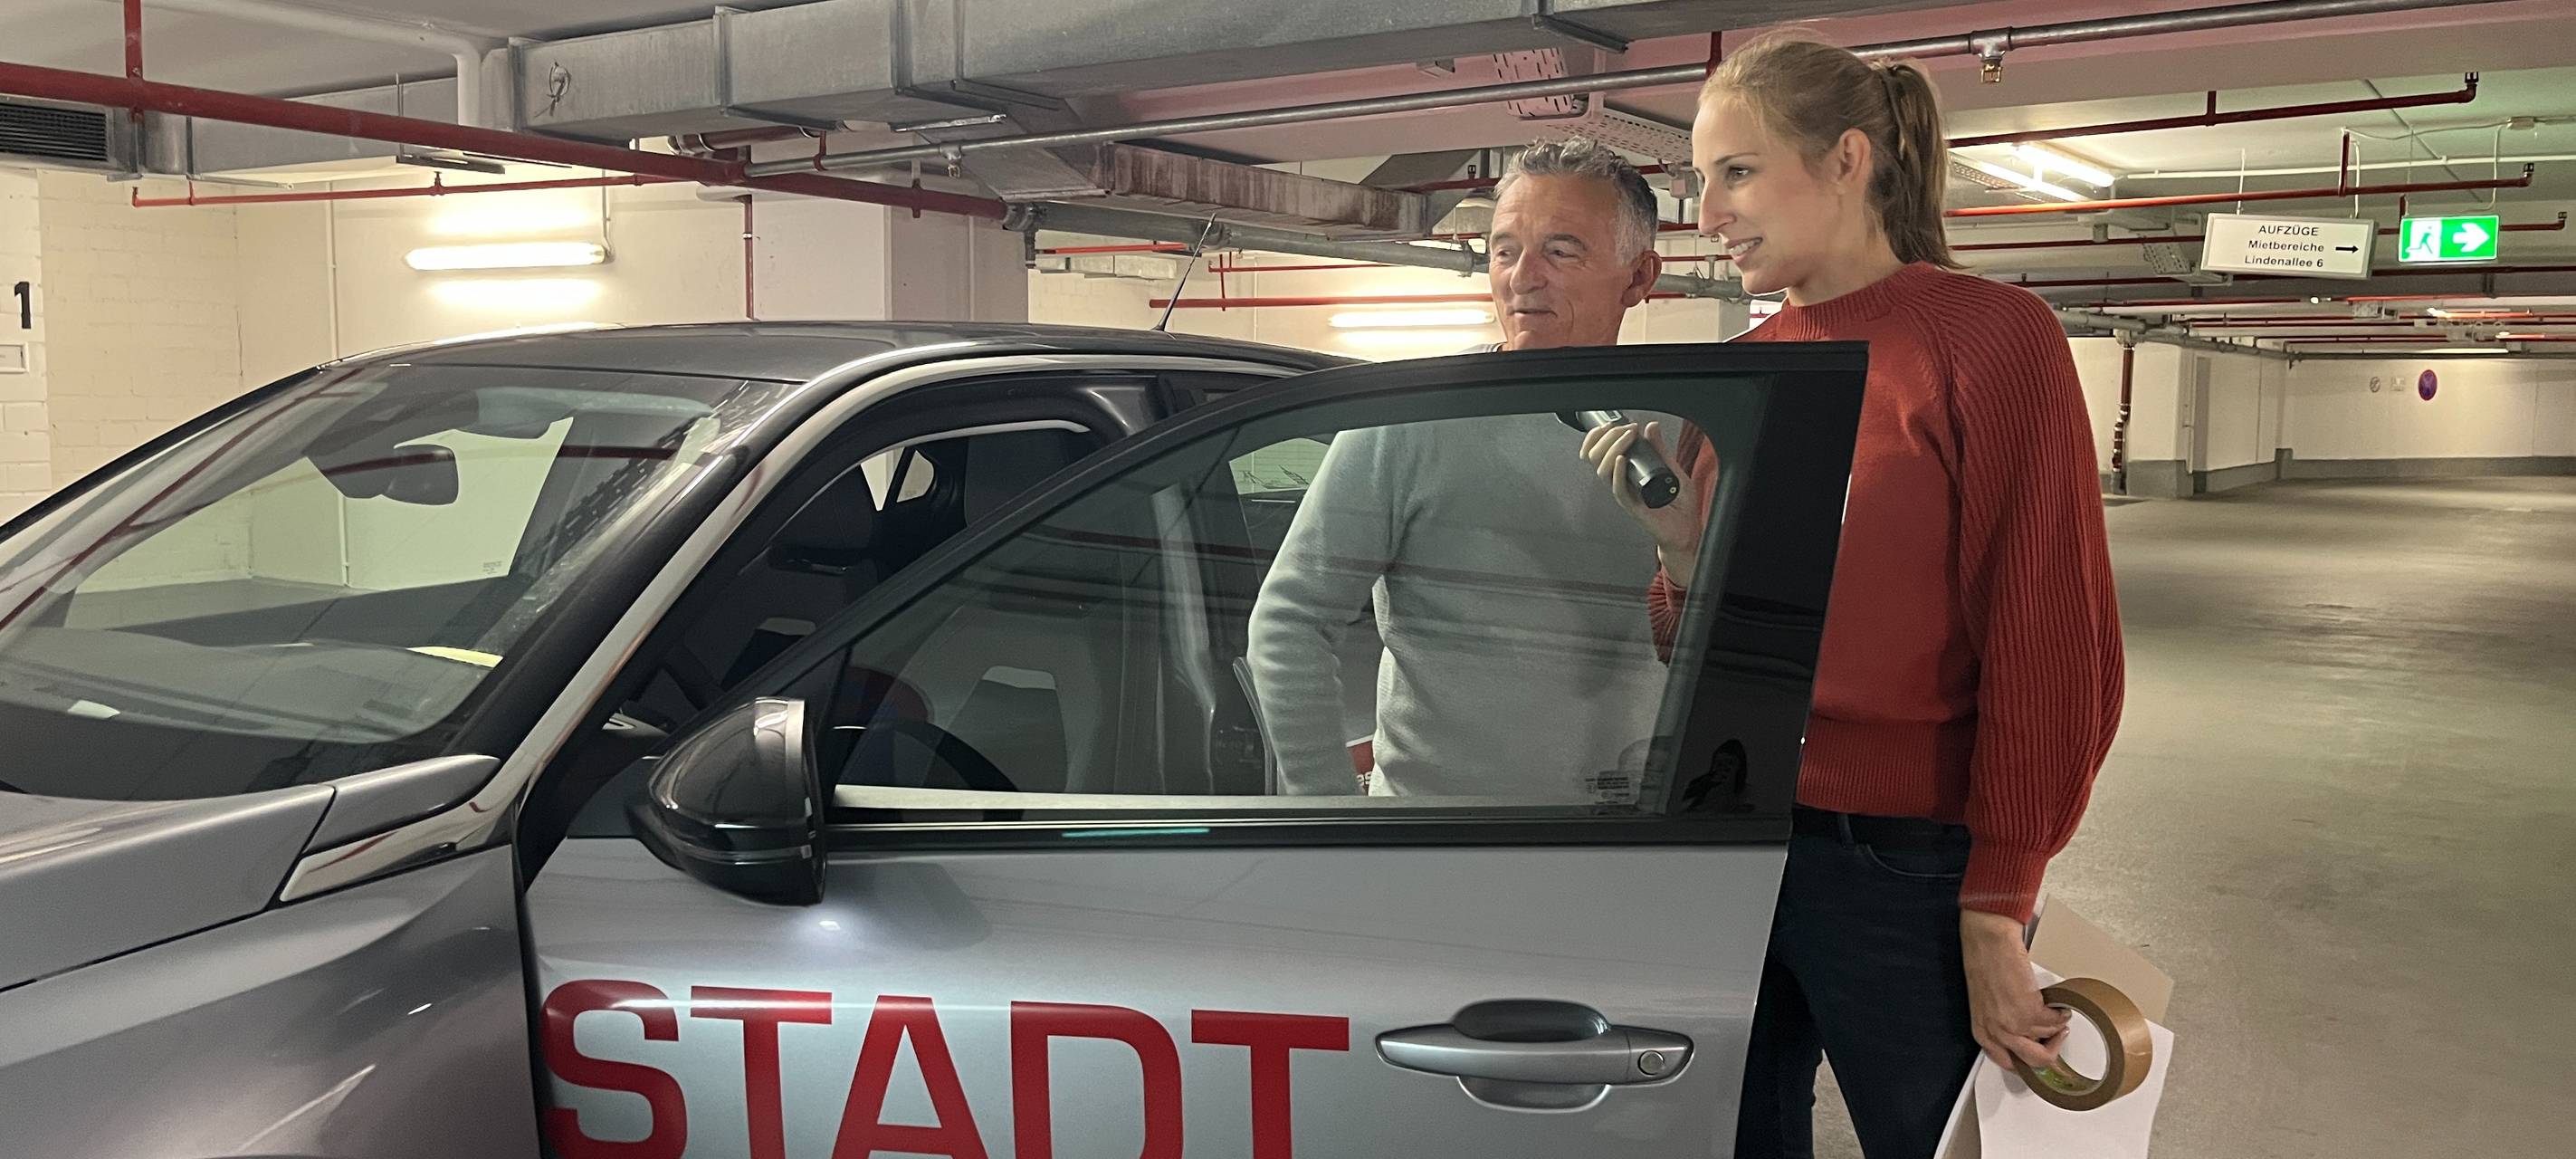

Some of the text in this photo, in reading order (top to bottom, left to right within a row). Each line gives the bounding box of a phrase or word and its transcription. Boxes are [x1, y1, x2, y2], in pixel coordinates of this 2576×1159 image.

[2258, 225, 2319, 236] AUFZÜGE
[2248, 240, 2324, 252] Mietbereiche
[2245, 255, 2323, 267] Lindenallee 6
[14, 281, 31, 329] 1
[544, 979, 1350, 1159] STADT
